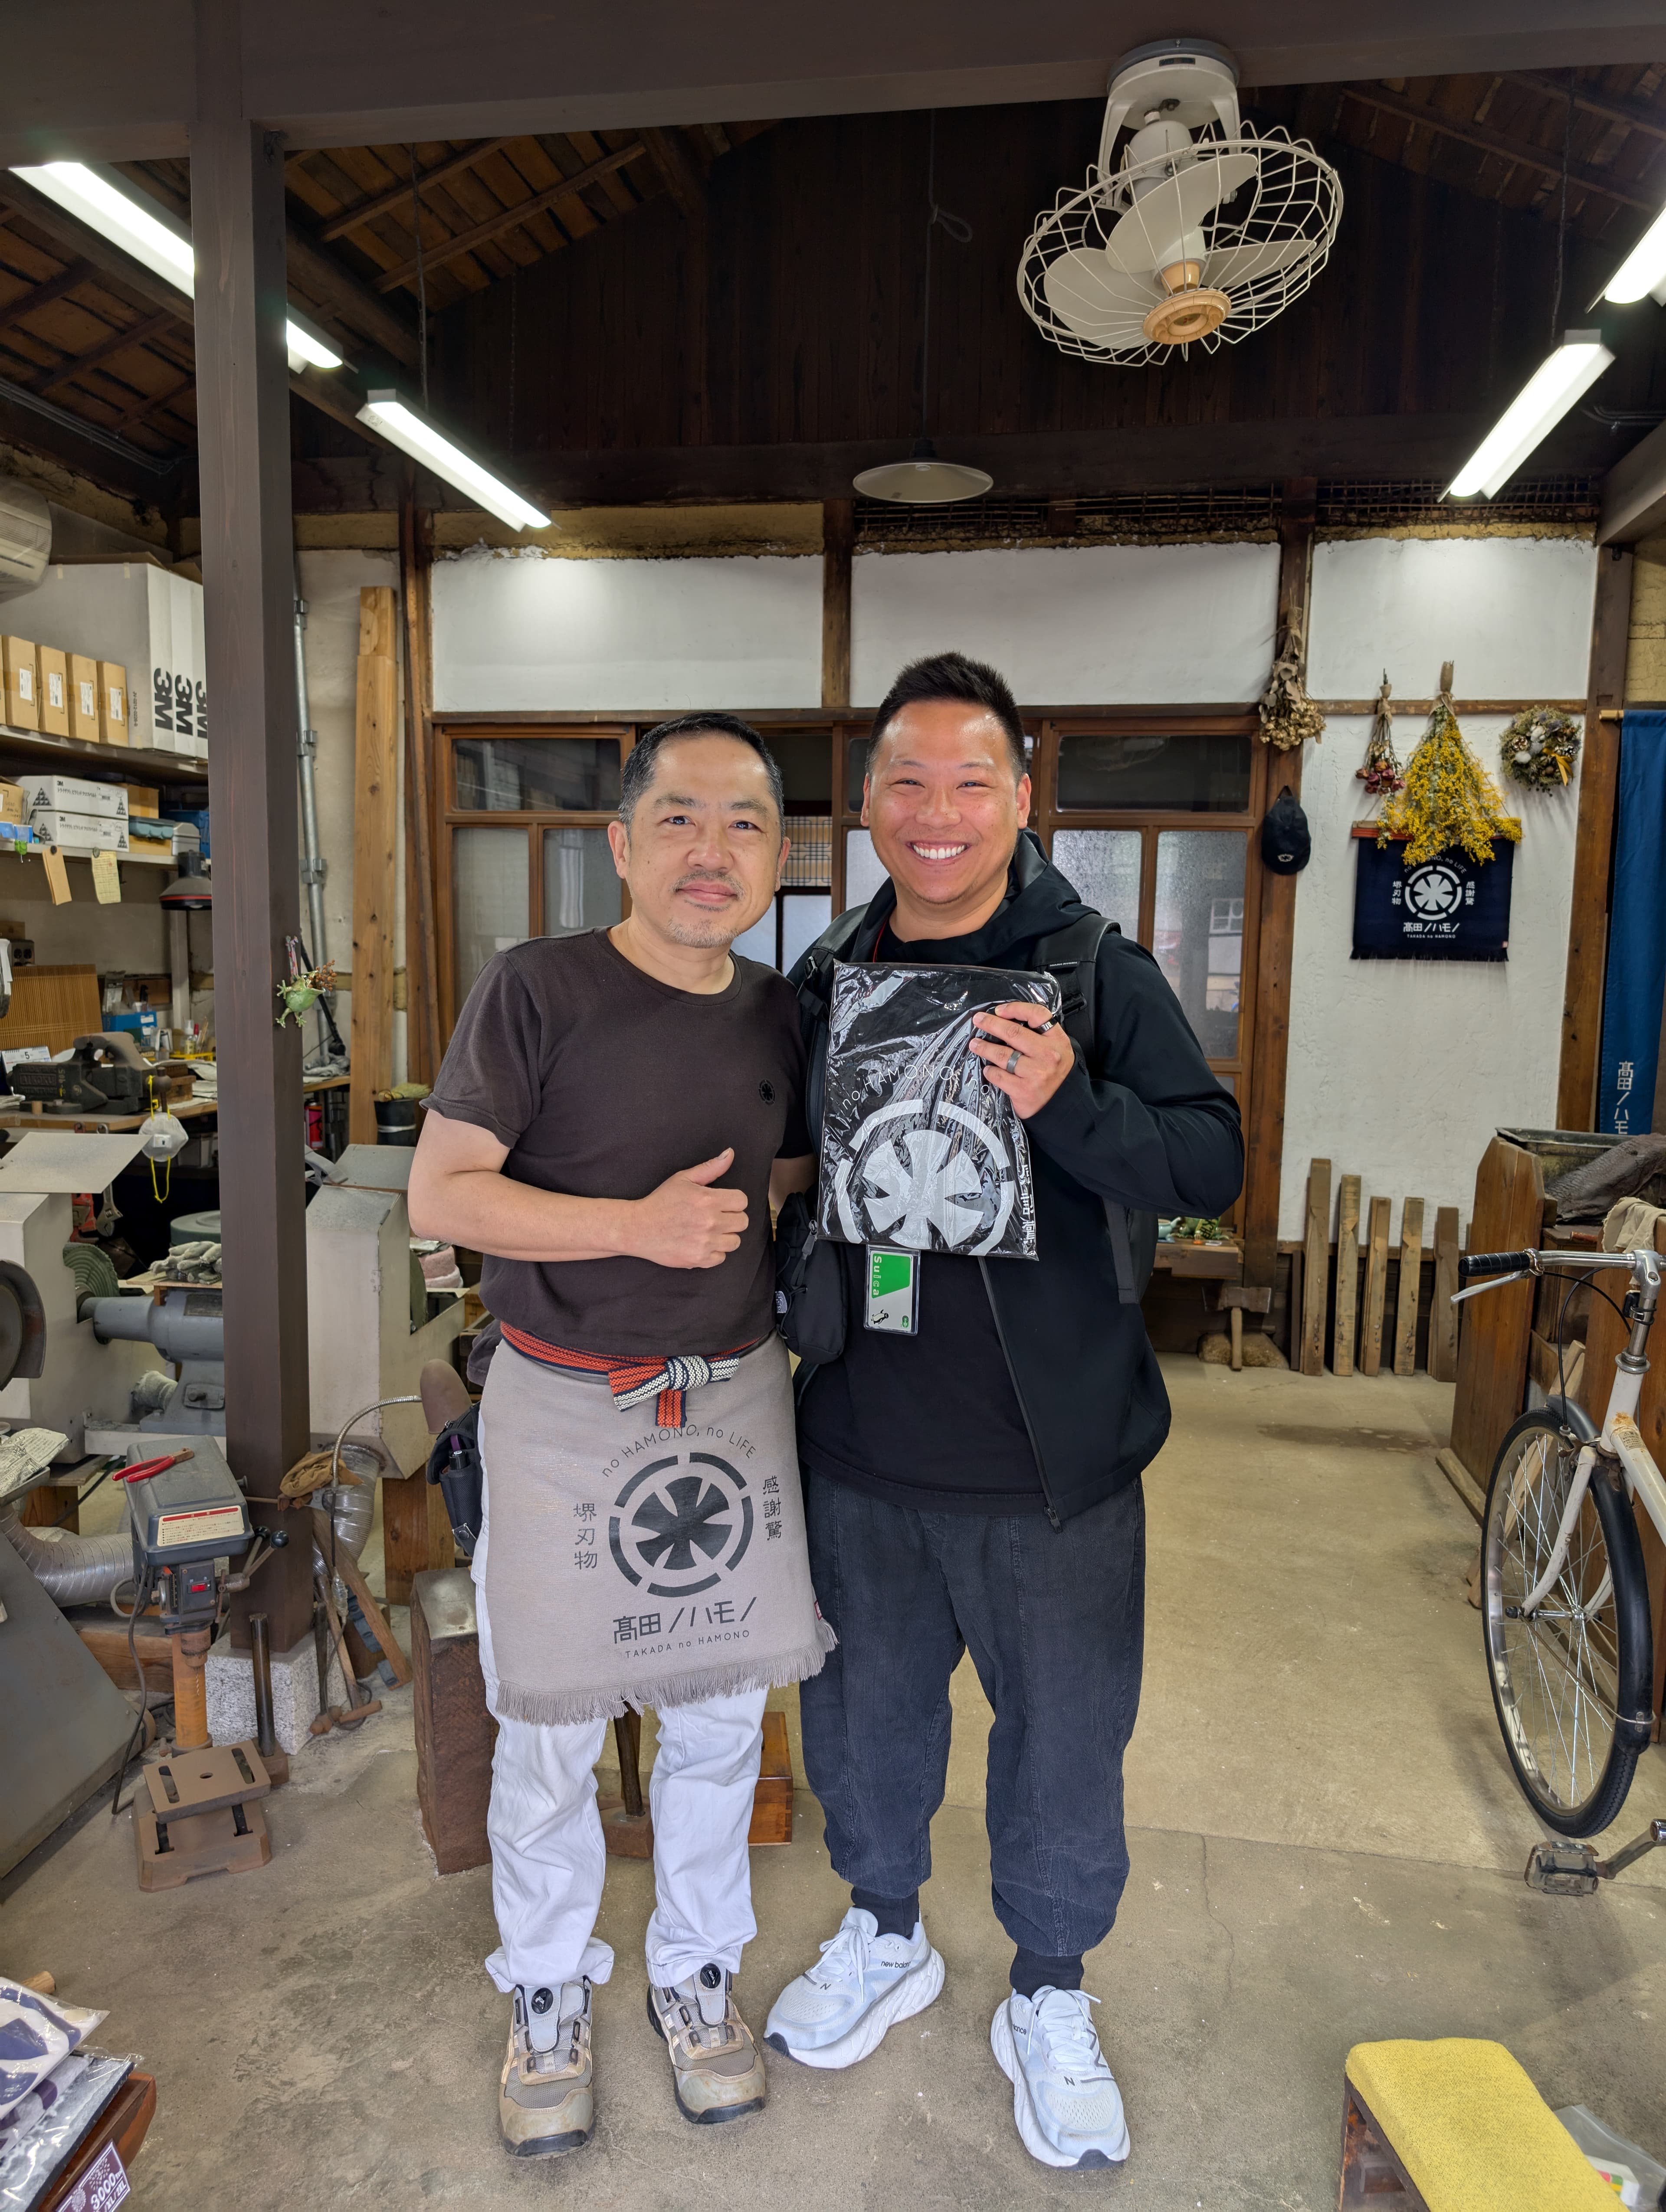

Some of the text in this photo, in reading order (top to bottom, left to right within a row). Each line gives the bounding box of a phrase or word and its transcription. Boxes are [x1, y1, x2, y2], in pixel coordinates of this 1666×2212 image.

[154, 668, 173, 730] 3M
[175, 674, 193, 736] 3M
[1454, 861, 1467, 874] LIFE
[842, 1090, 861, 1111] no
[872, 1256, 882, 1296] Suica
[602, 1424, 756, 1477] no HAMONO, no LIFE
[573, 1503, 597, 1570] 堺刃物
[625, 1630, 750, 1659] TAKADA no HAMONO
[91, 2173, 116, 2210] 3000
